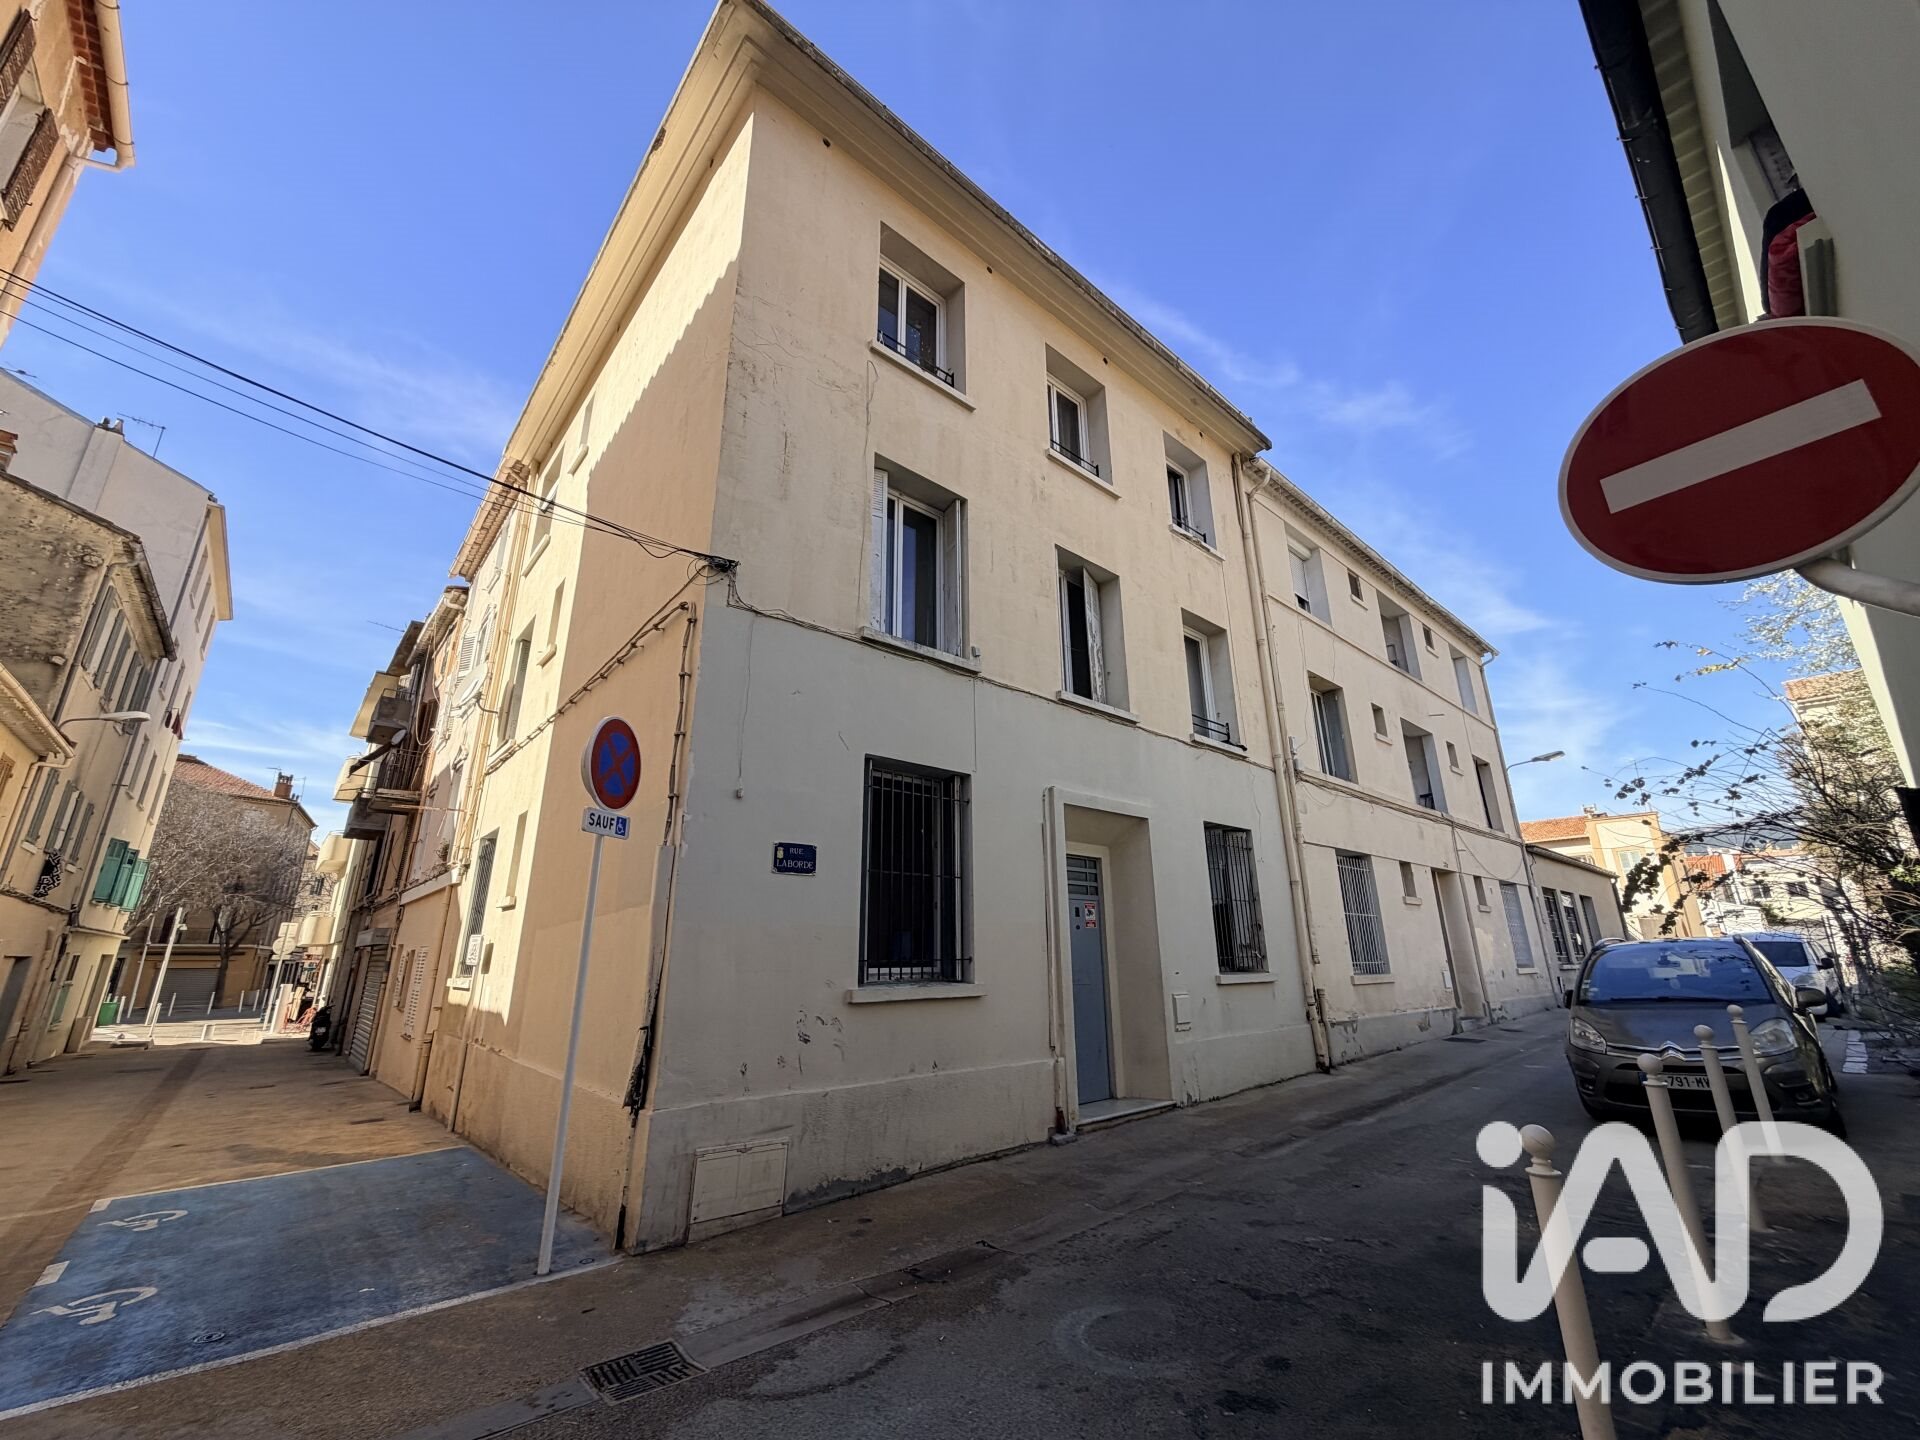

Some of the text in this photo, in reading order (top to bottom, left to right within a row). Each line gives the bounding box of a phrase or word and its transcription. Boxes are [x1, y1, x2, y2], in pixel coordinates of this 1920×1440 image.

[588, 812, 615, 830] SAUF
[789, 847, 805, 855] RUE
[776, 859, 814, 870] LABORDE
